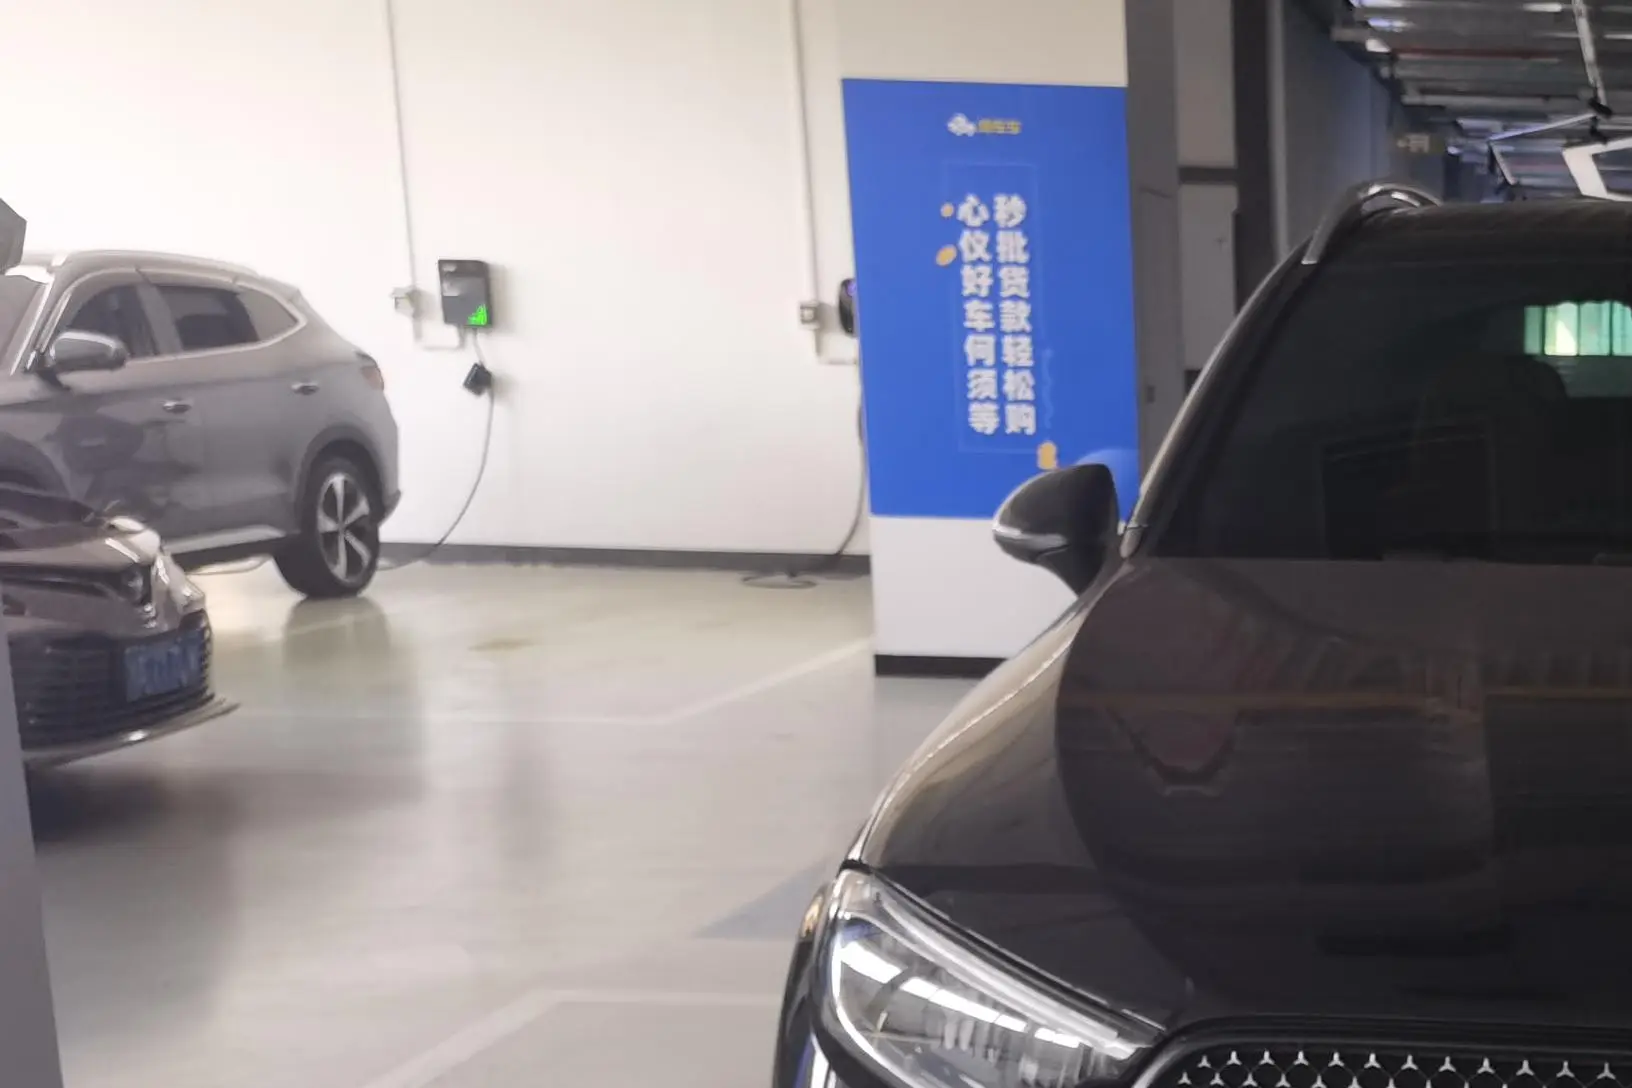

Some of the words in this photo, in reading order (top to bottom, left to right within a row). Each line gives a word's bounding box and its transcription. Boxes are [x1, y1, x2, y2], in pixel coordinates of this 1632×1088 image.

[958, 194, 999, 435] 心仪好车何须等
